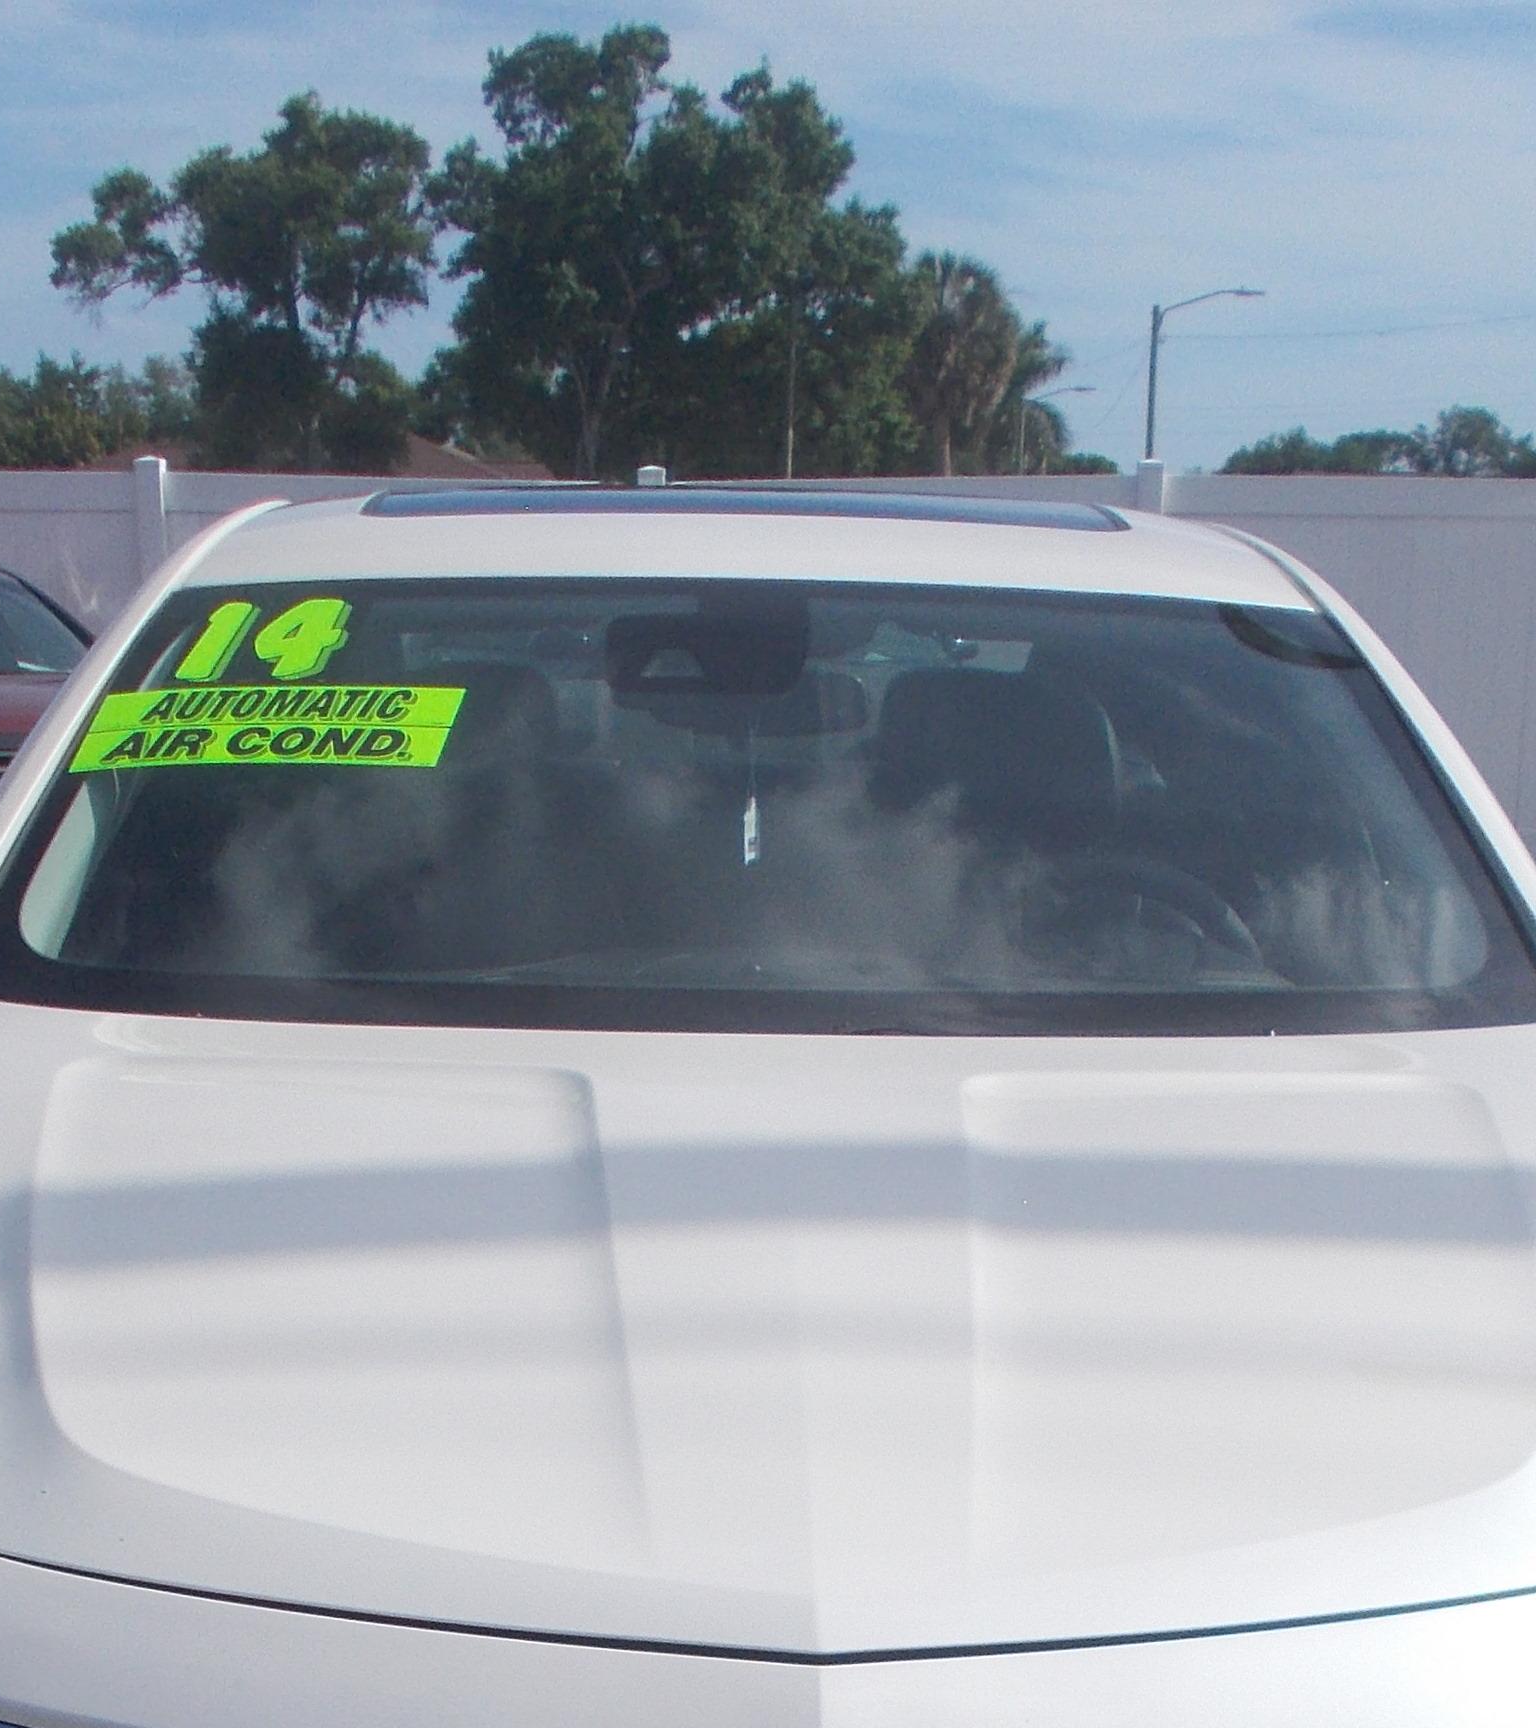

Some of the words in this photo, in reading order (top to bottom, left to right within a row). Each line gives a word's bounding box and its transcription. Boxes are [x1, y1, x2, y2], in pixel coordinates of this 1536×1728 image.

[175, 599, 352, 681] 14
[141, 689, 417, 723] AUTOMATIC
[101, 728, 217, 764] AIR
[226, 727, 414, 761] COND.
